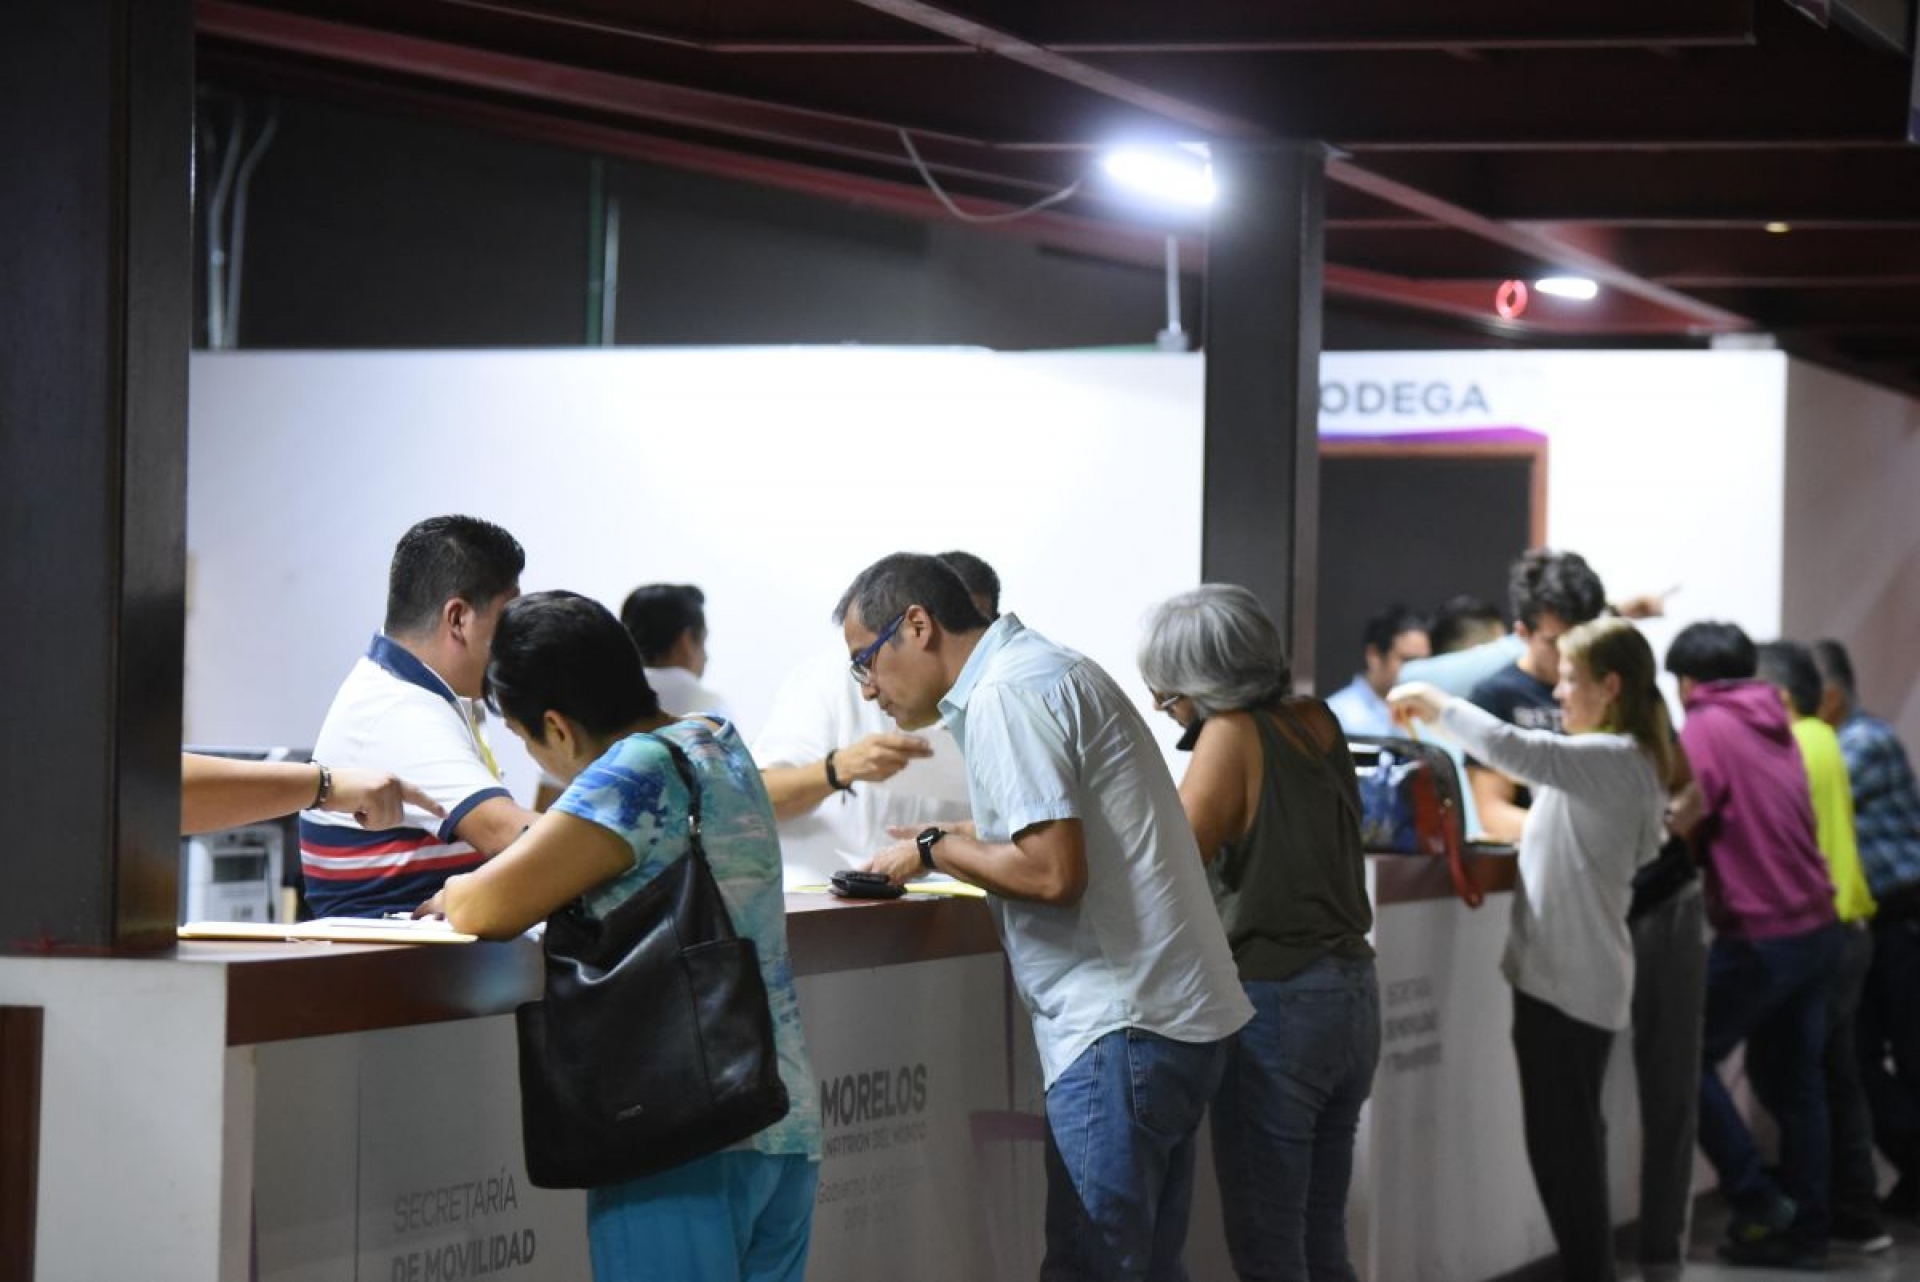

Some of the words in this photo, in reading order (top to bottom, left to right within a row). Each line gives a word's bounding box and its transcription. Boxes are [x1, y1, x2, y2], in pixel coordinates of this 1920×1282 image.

[1319, 380, 1488, 415] ODEGA
[821, 1063, 927, 1128] MORELOS
[394, 1166, 517, 1233] SECRETARÍA
[392, 1253, 420, 1282] DE
[424, 1229, 535, 1282] MOVILIDAD
